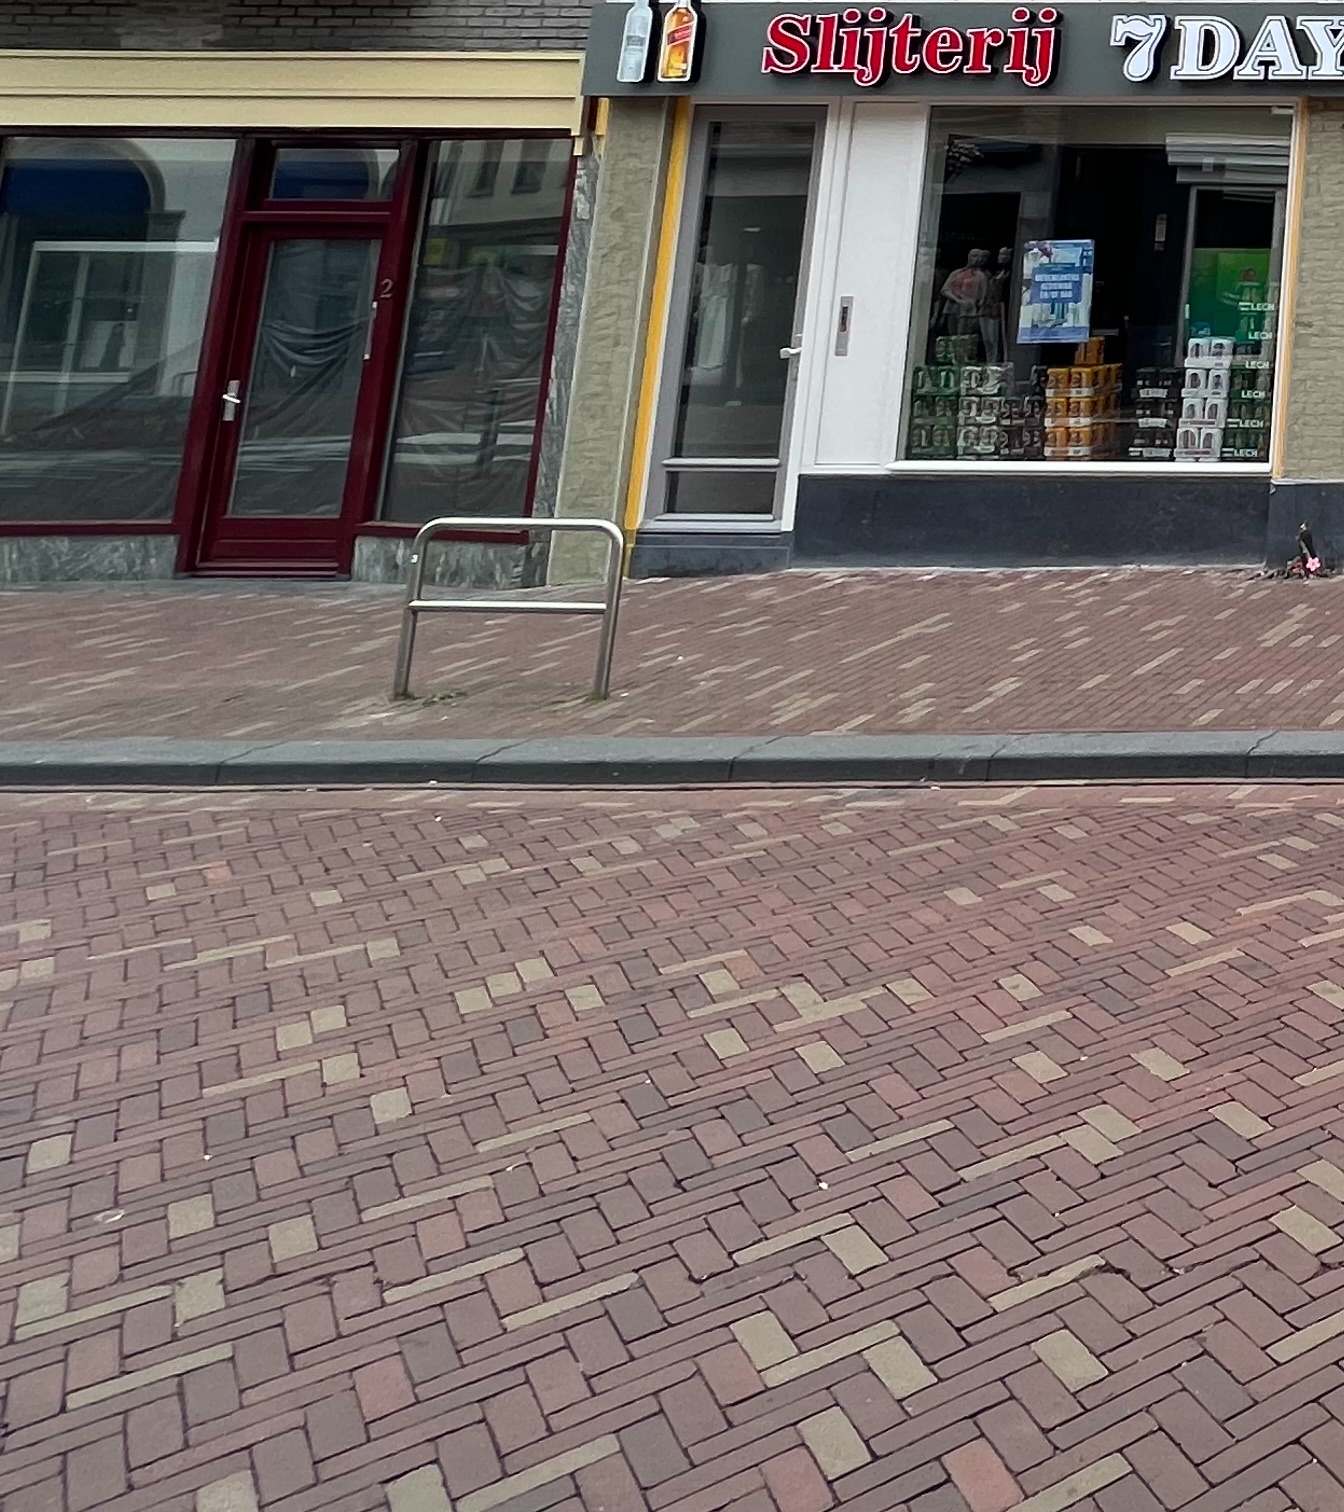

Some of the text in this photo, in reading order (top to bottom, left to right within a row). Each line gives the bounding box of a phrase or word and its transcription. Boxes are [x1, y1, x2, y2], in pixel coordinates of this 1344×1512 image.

[760, 7, 1056, 87] Slijterij
[380, 278, 394, 298] 2
[1251, 303, 1275, 311] LECH
[1248, 331, 1273, 340] LECH
[1245, 361, 1270, 369] LECH
[1241, 390, 1266, 399] LECH
[1239, 419, 1263, 428] LECH
[1234, 448, 1258, 457] LECH
